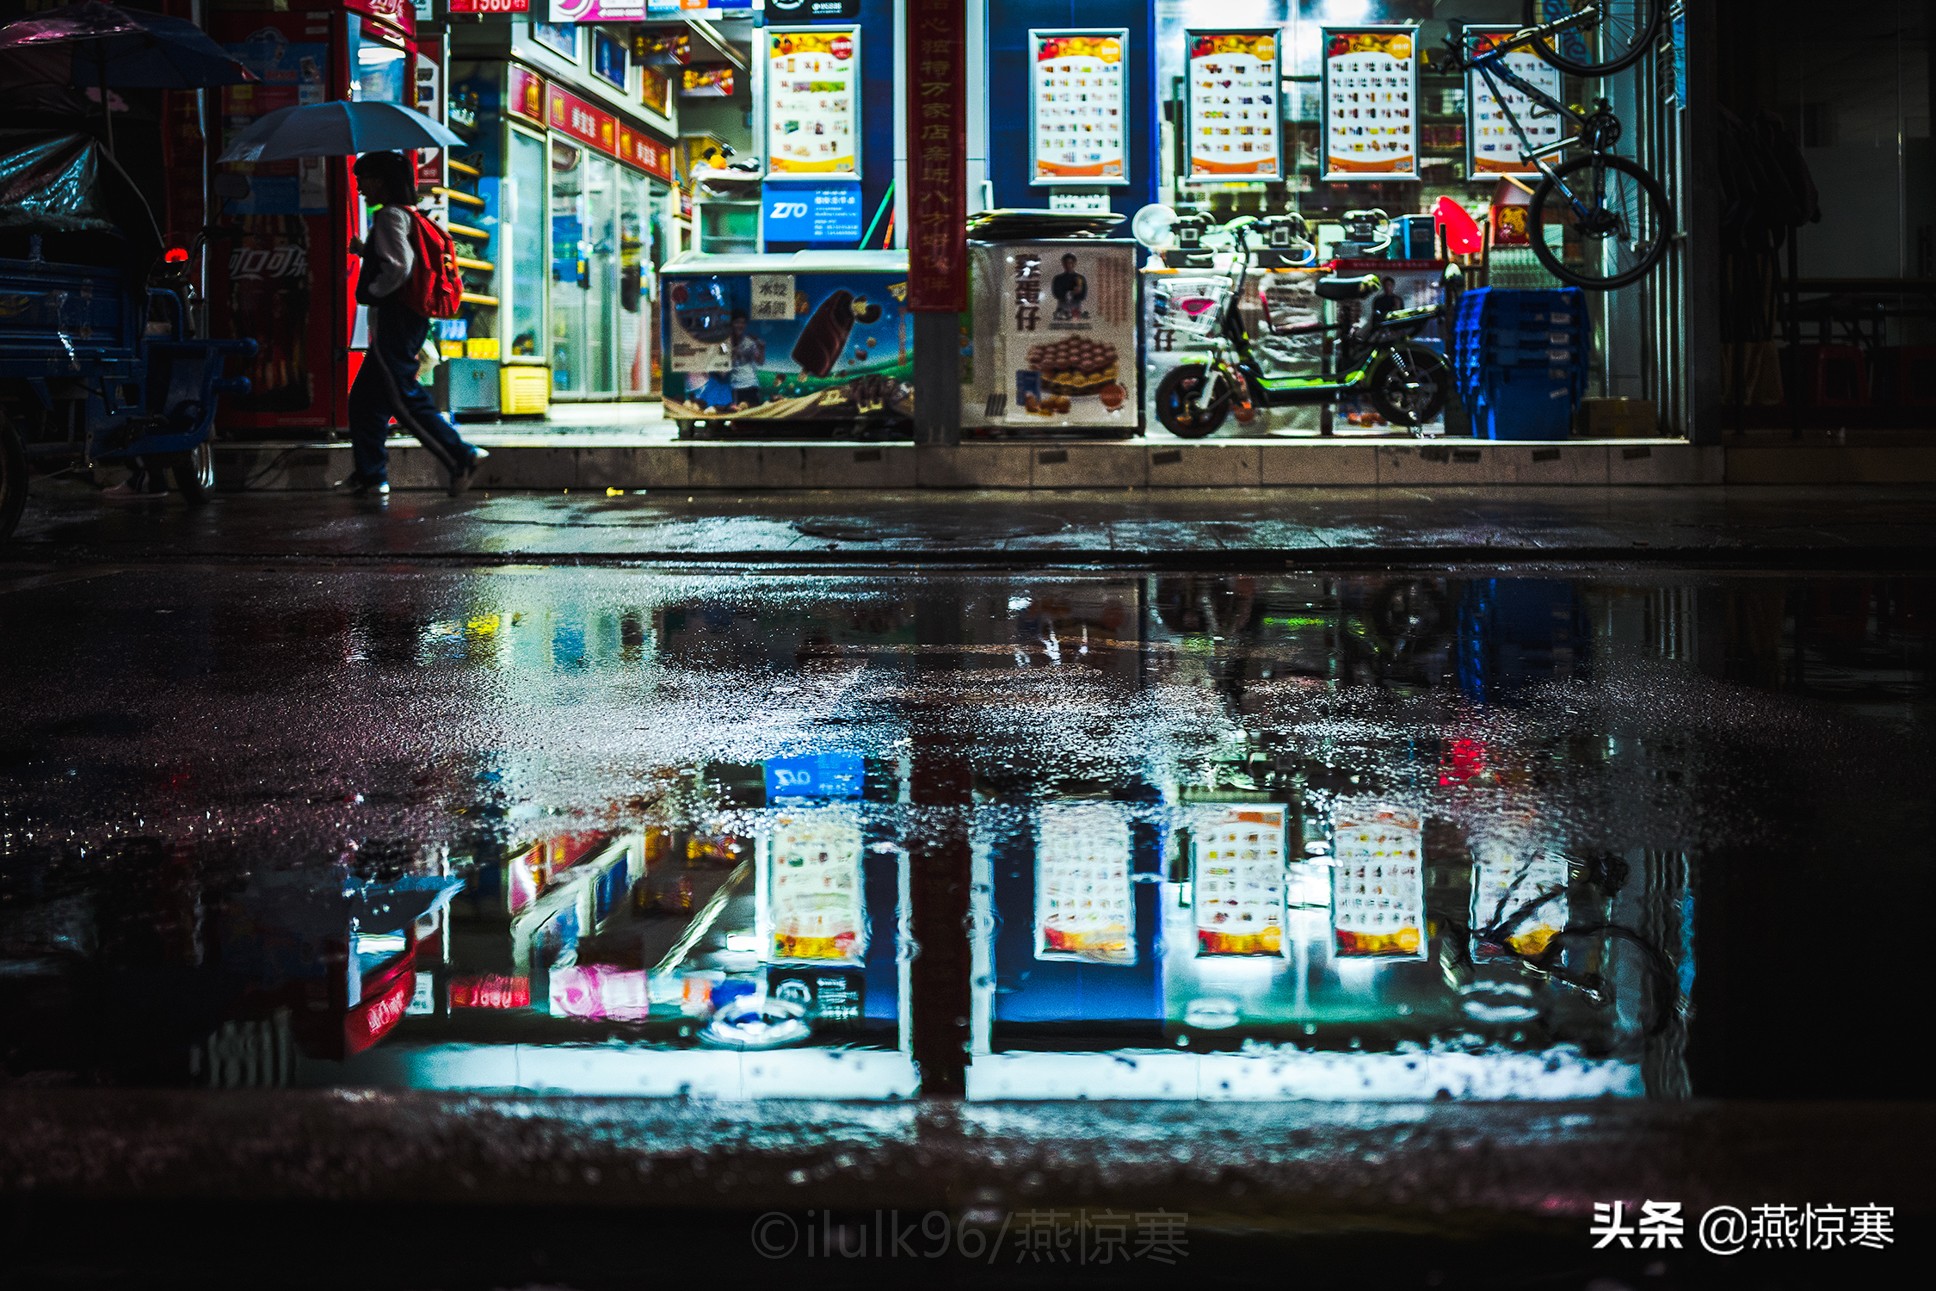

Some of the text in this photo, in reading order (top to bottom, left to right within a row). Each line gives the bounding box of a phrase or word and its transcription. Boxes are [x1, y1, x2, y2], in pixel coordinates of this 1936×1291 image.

[769, 202, 808, 219] ZTO
[228, 244, 308, 280] 可口可乐
